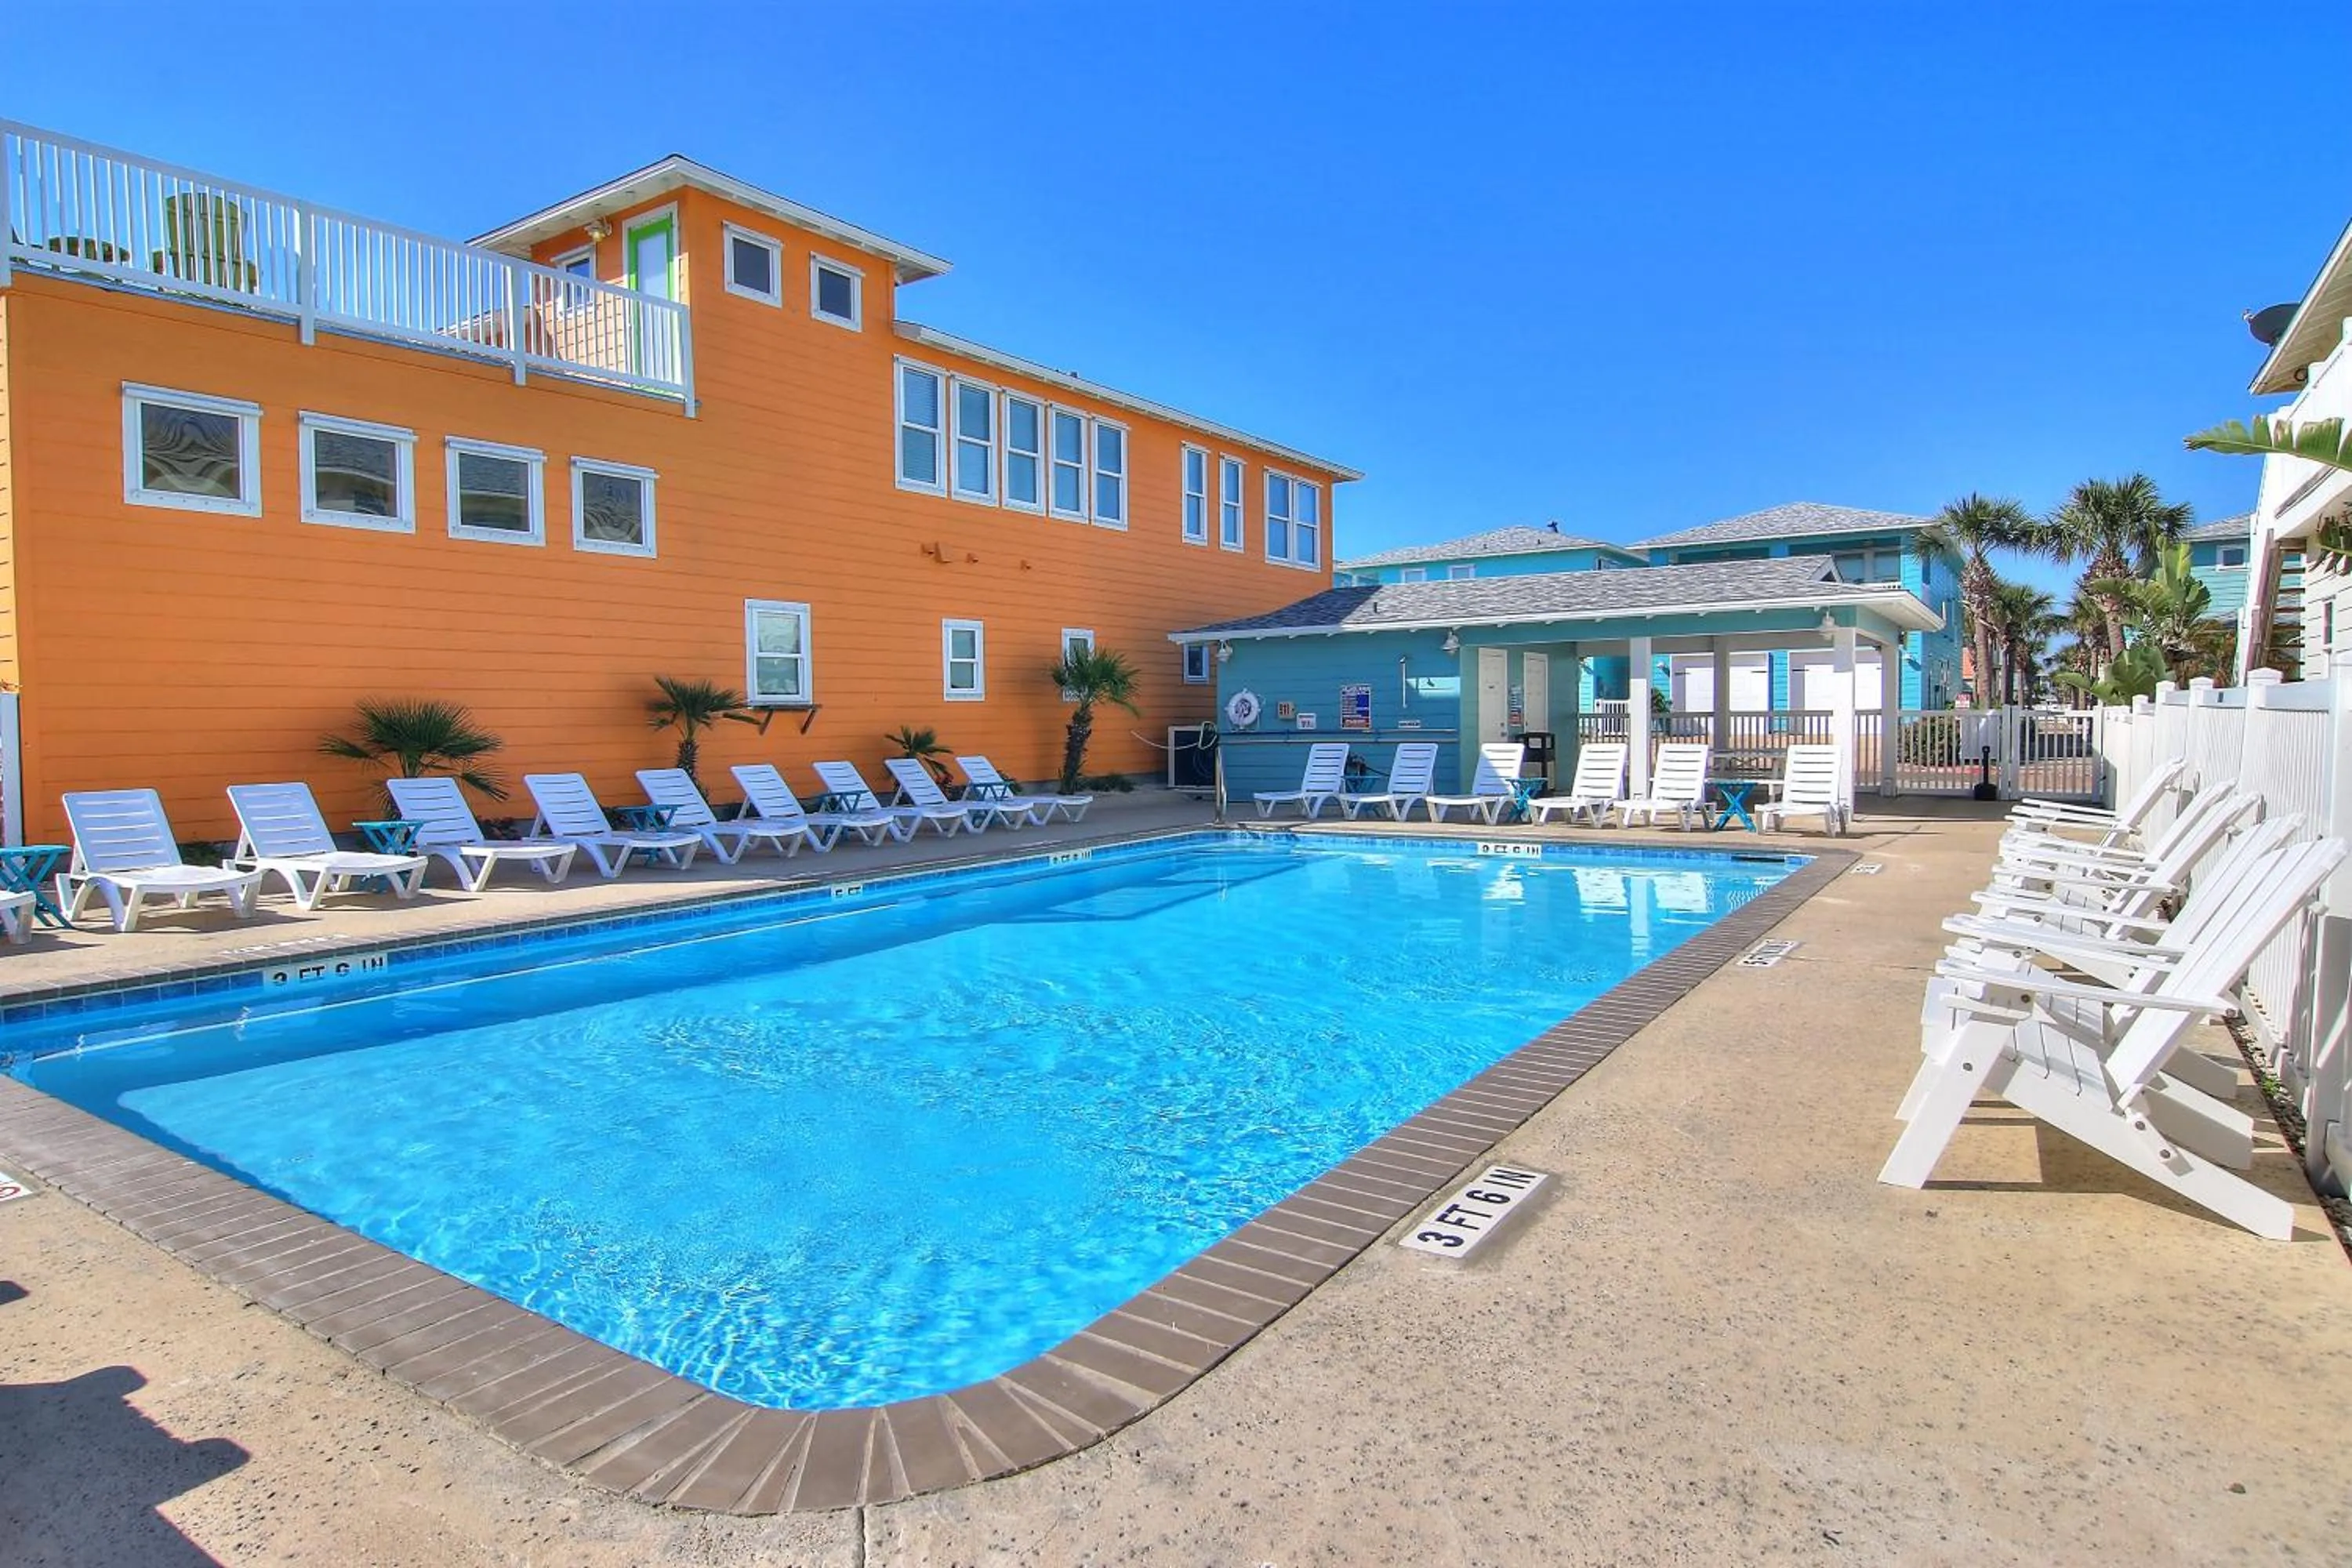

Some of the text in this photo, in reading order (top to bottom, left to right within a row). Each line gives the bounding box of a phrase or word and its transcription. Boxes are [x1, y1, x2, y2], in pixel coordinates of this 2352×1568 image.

[362, 956, 383, 971] IN
[1417, 1169, 1537, 1247] 3 FT 6 IN
